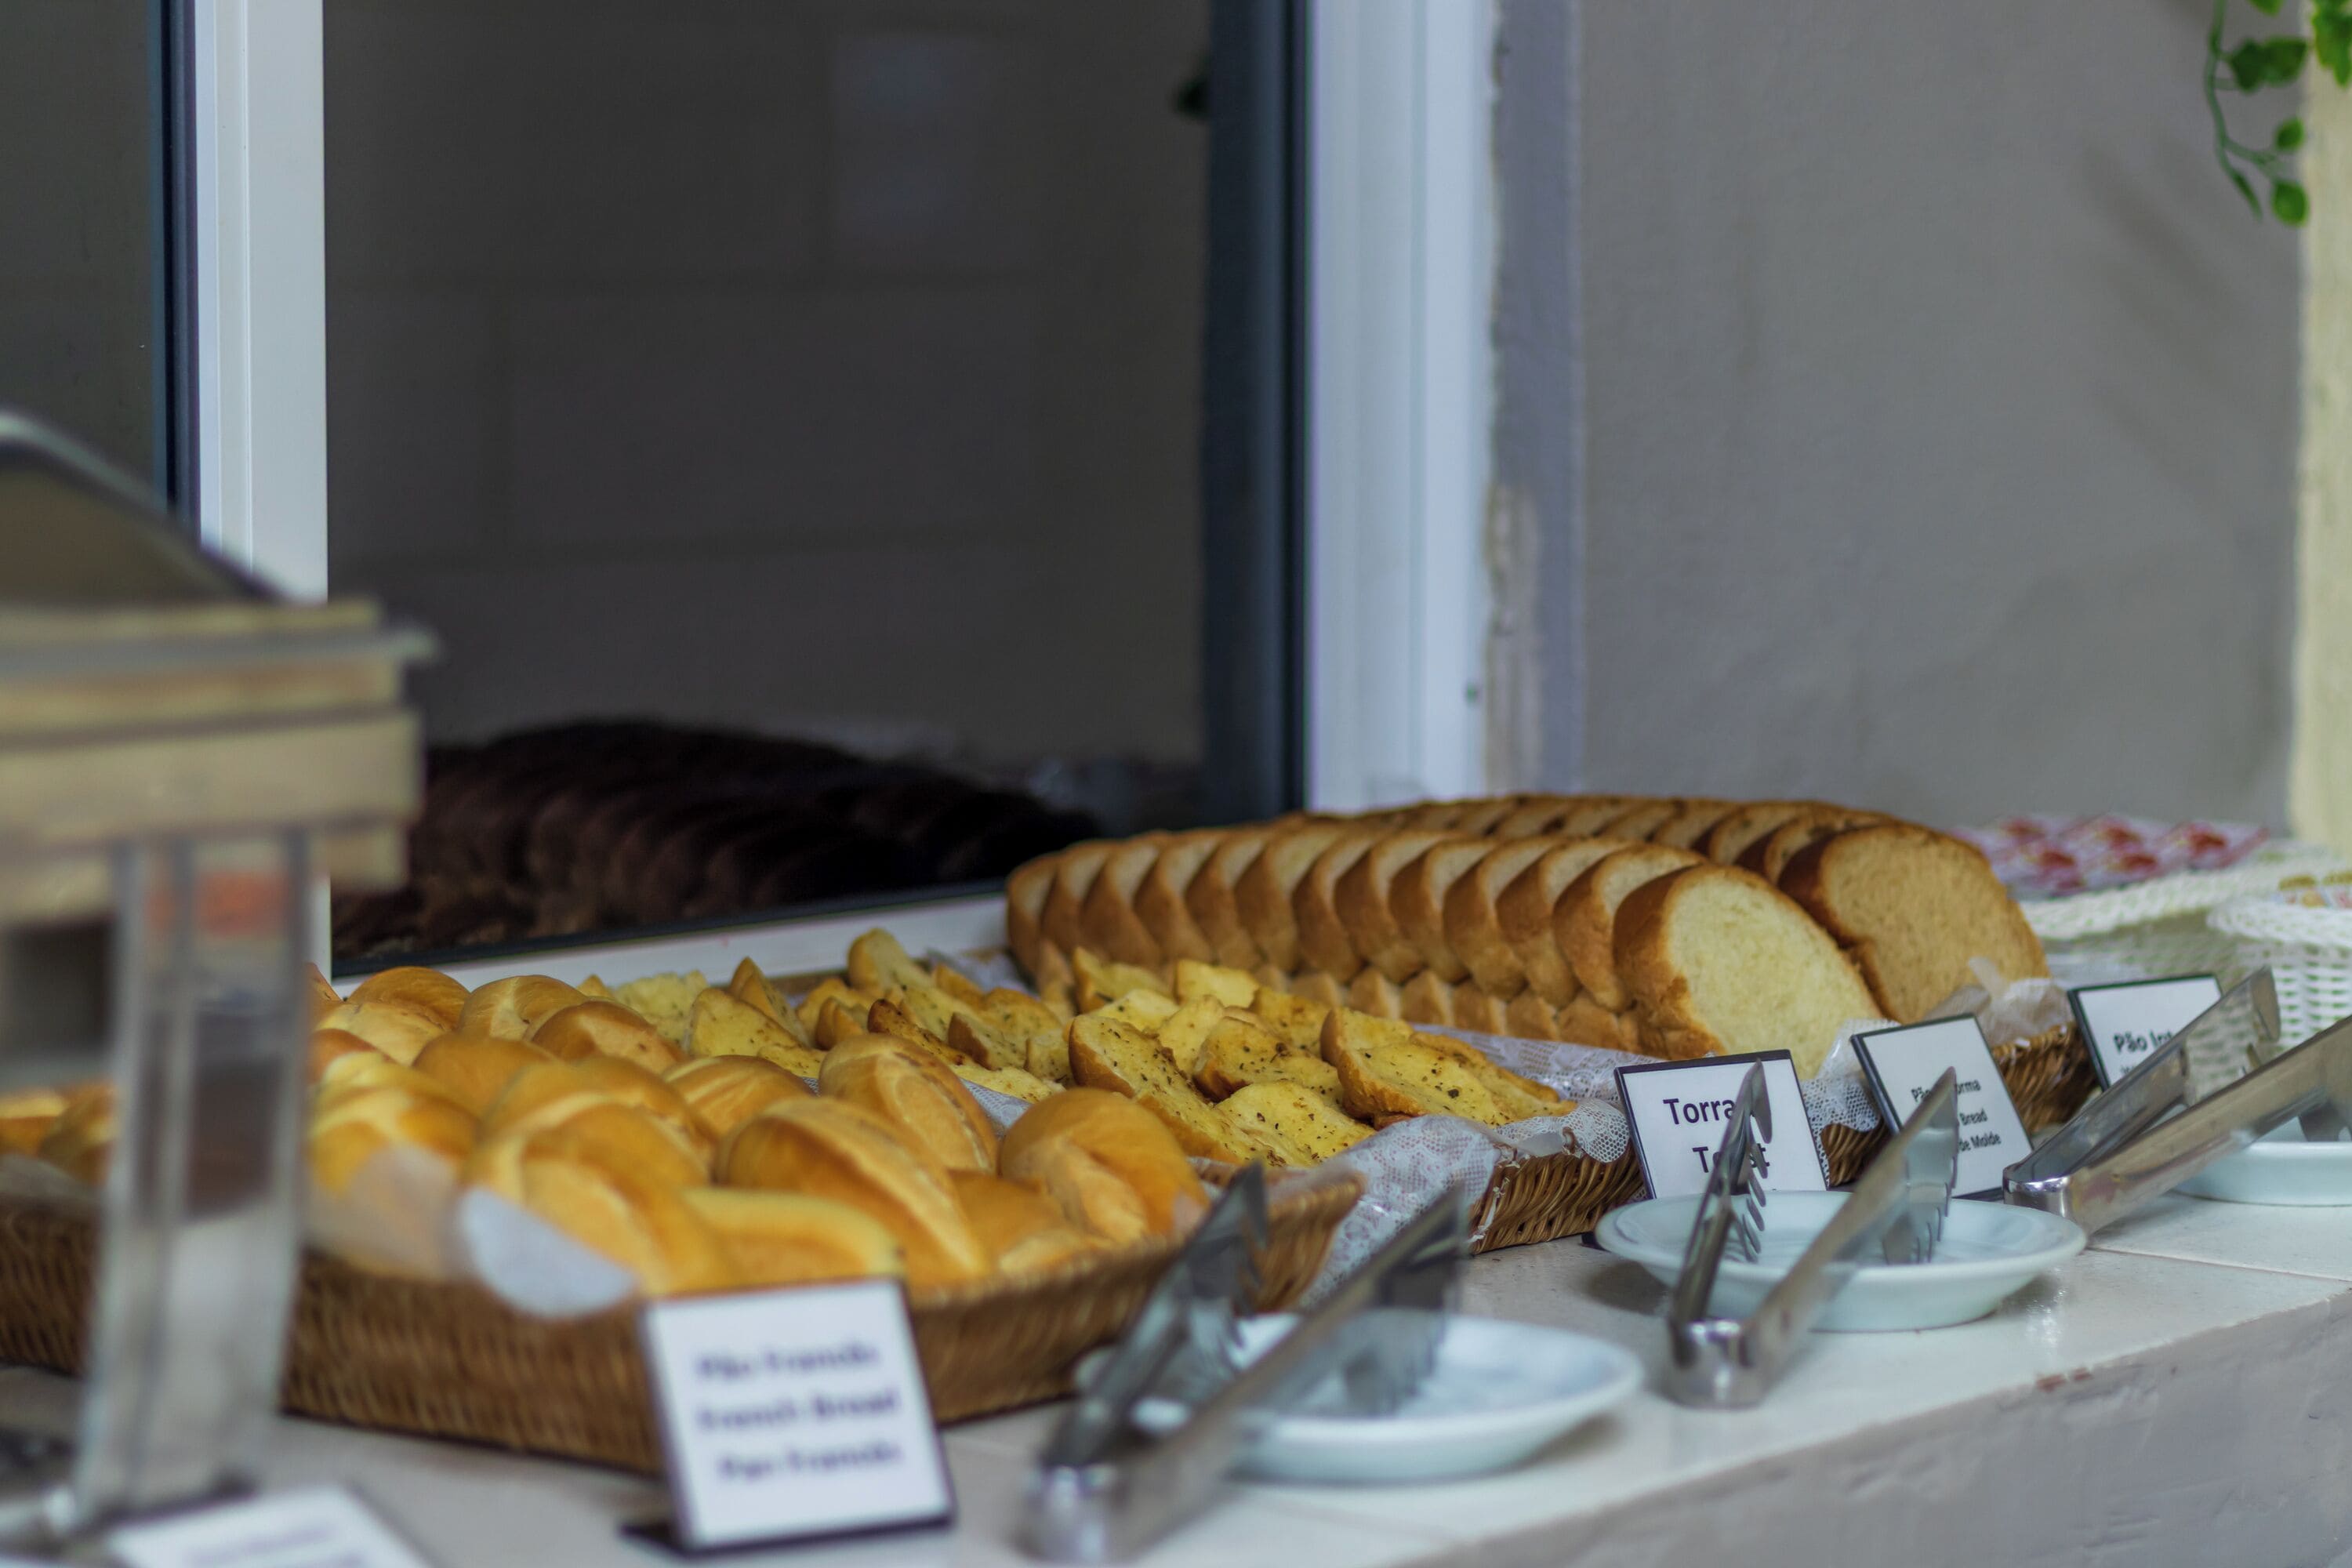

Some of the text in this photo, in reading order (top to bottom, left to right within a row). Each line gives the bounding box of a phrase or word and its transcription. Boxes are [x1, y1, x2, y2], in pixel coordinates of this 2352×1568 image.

[2113, 1030, 2147, 1054] Pão
[1956, 1079, 1981, 1094] orma
[1959, 1108, 1987, 1126] Bread
[1971, 1131, 2002, 1149] Molde
